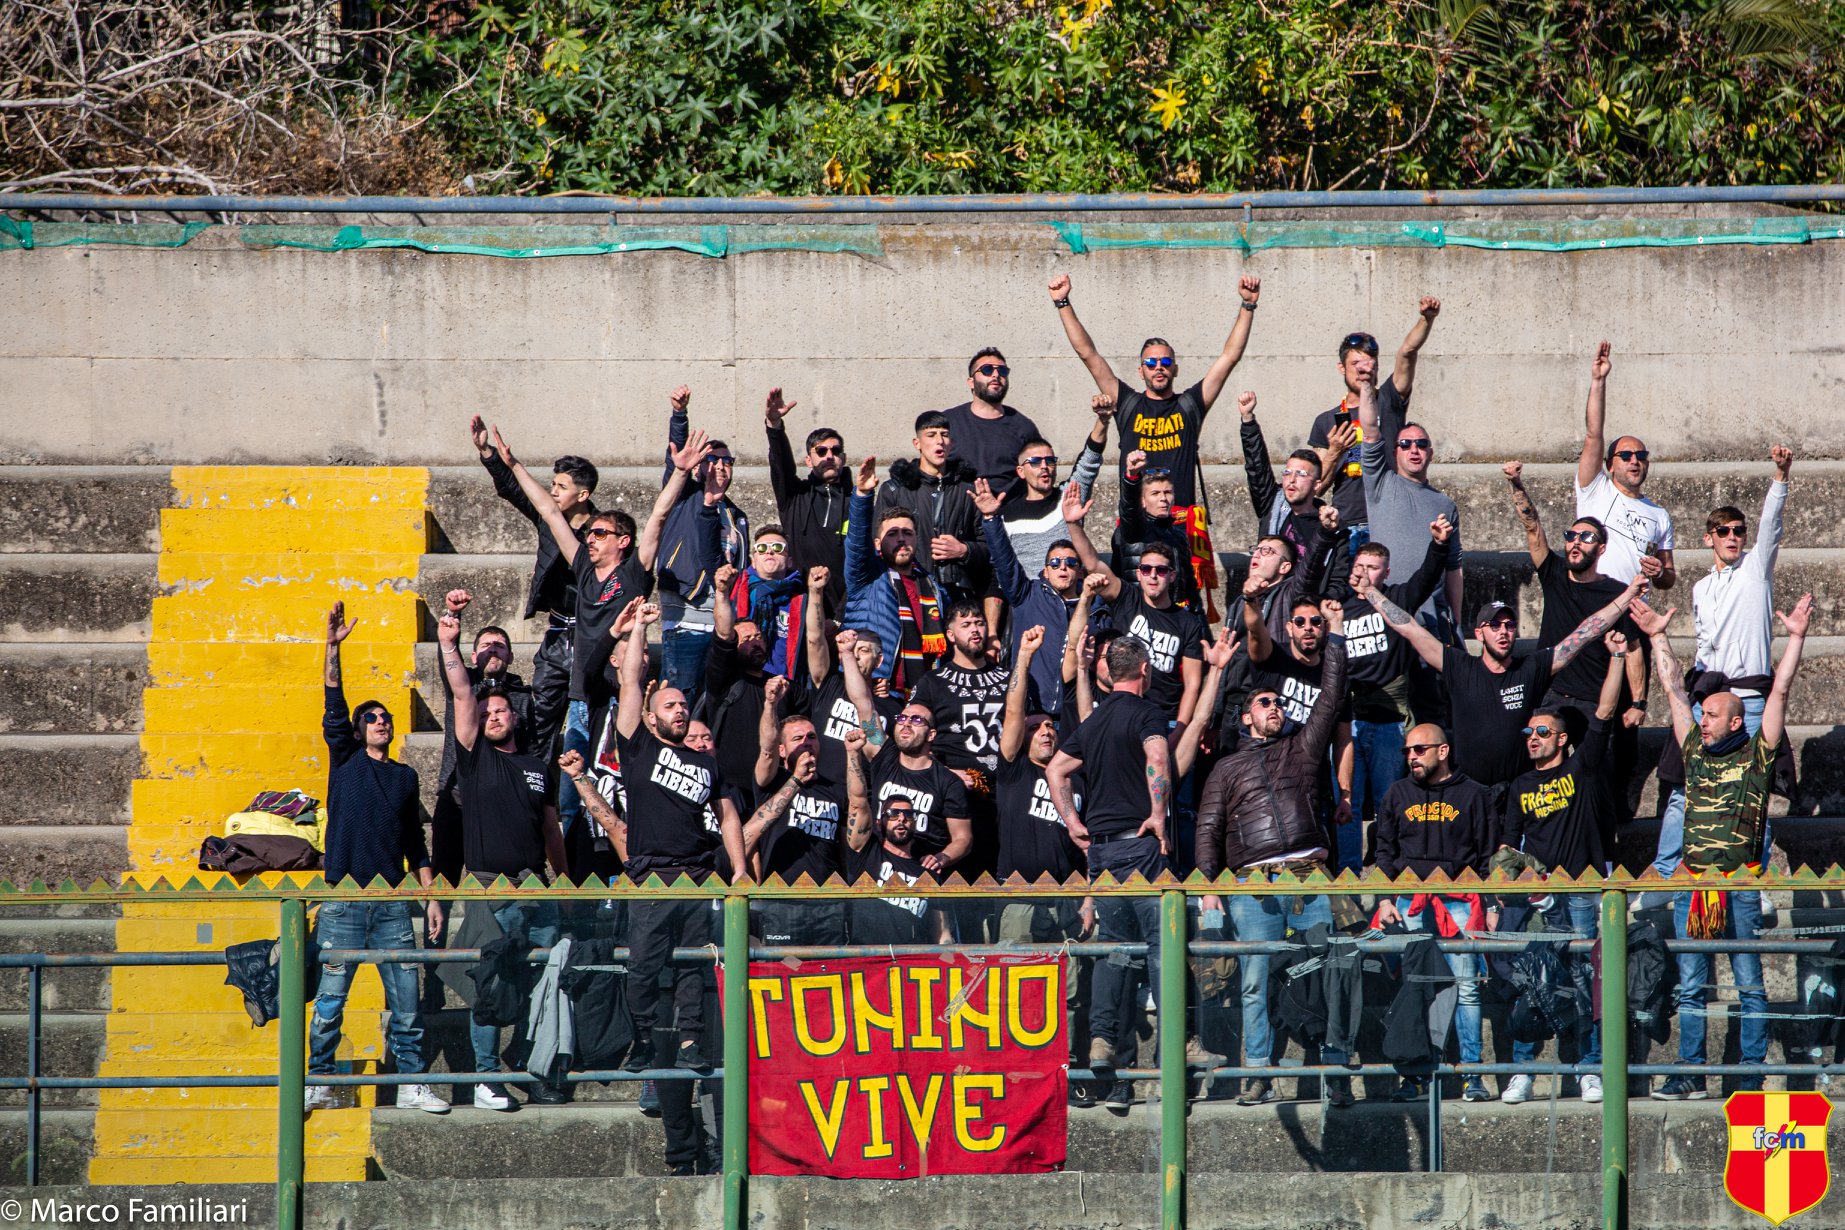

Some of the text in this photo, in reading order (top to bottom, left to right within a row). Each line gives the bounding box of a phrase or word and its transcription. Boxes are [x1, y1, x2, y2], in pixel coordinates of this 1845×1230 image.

[1139, 433, 1182, 452] MESSINA
[1129, 614, 1181, 657] ORZIO
[1343, 612, 1385, 639] RAZIO
[1345, 633, 1389, 659] BERO
[961, 702, 1005, 753] 53
[650, 763, 711, 804] LIBERO
[788, 808, 839, 841] LIBERO
[749, 963, 1061, 1060] TONINO
[797, 1072, 1008, 1164] VIVE
